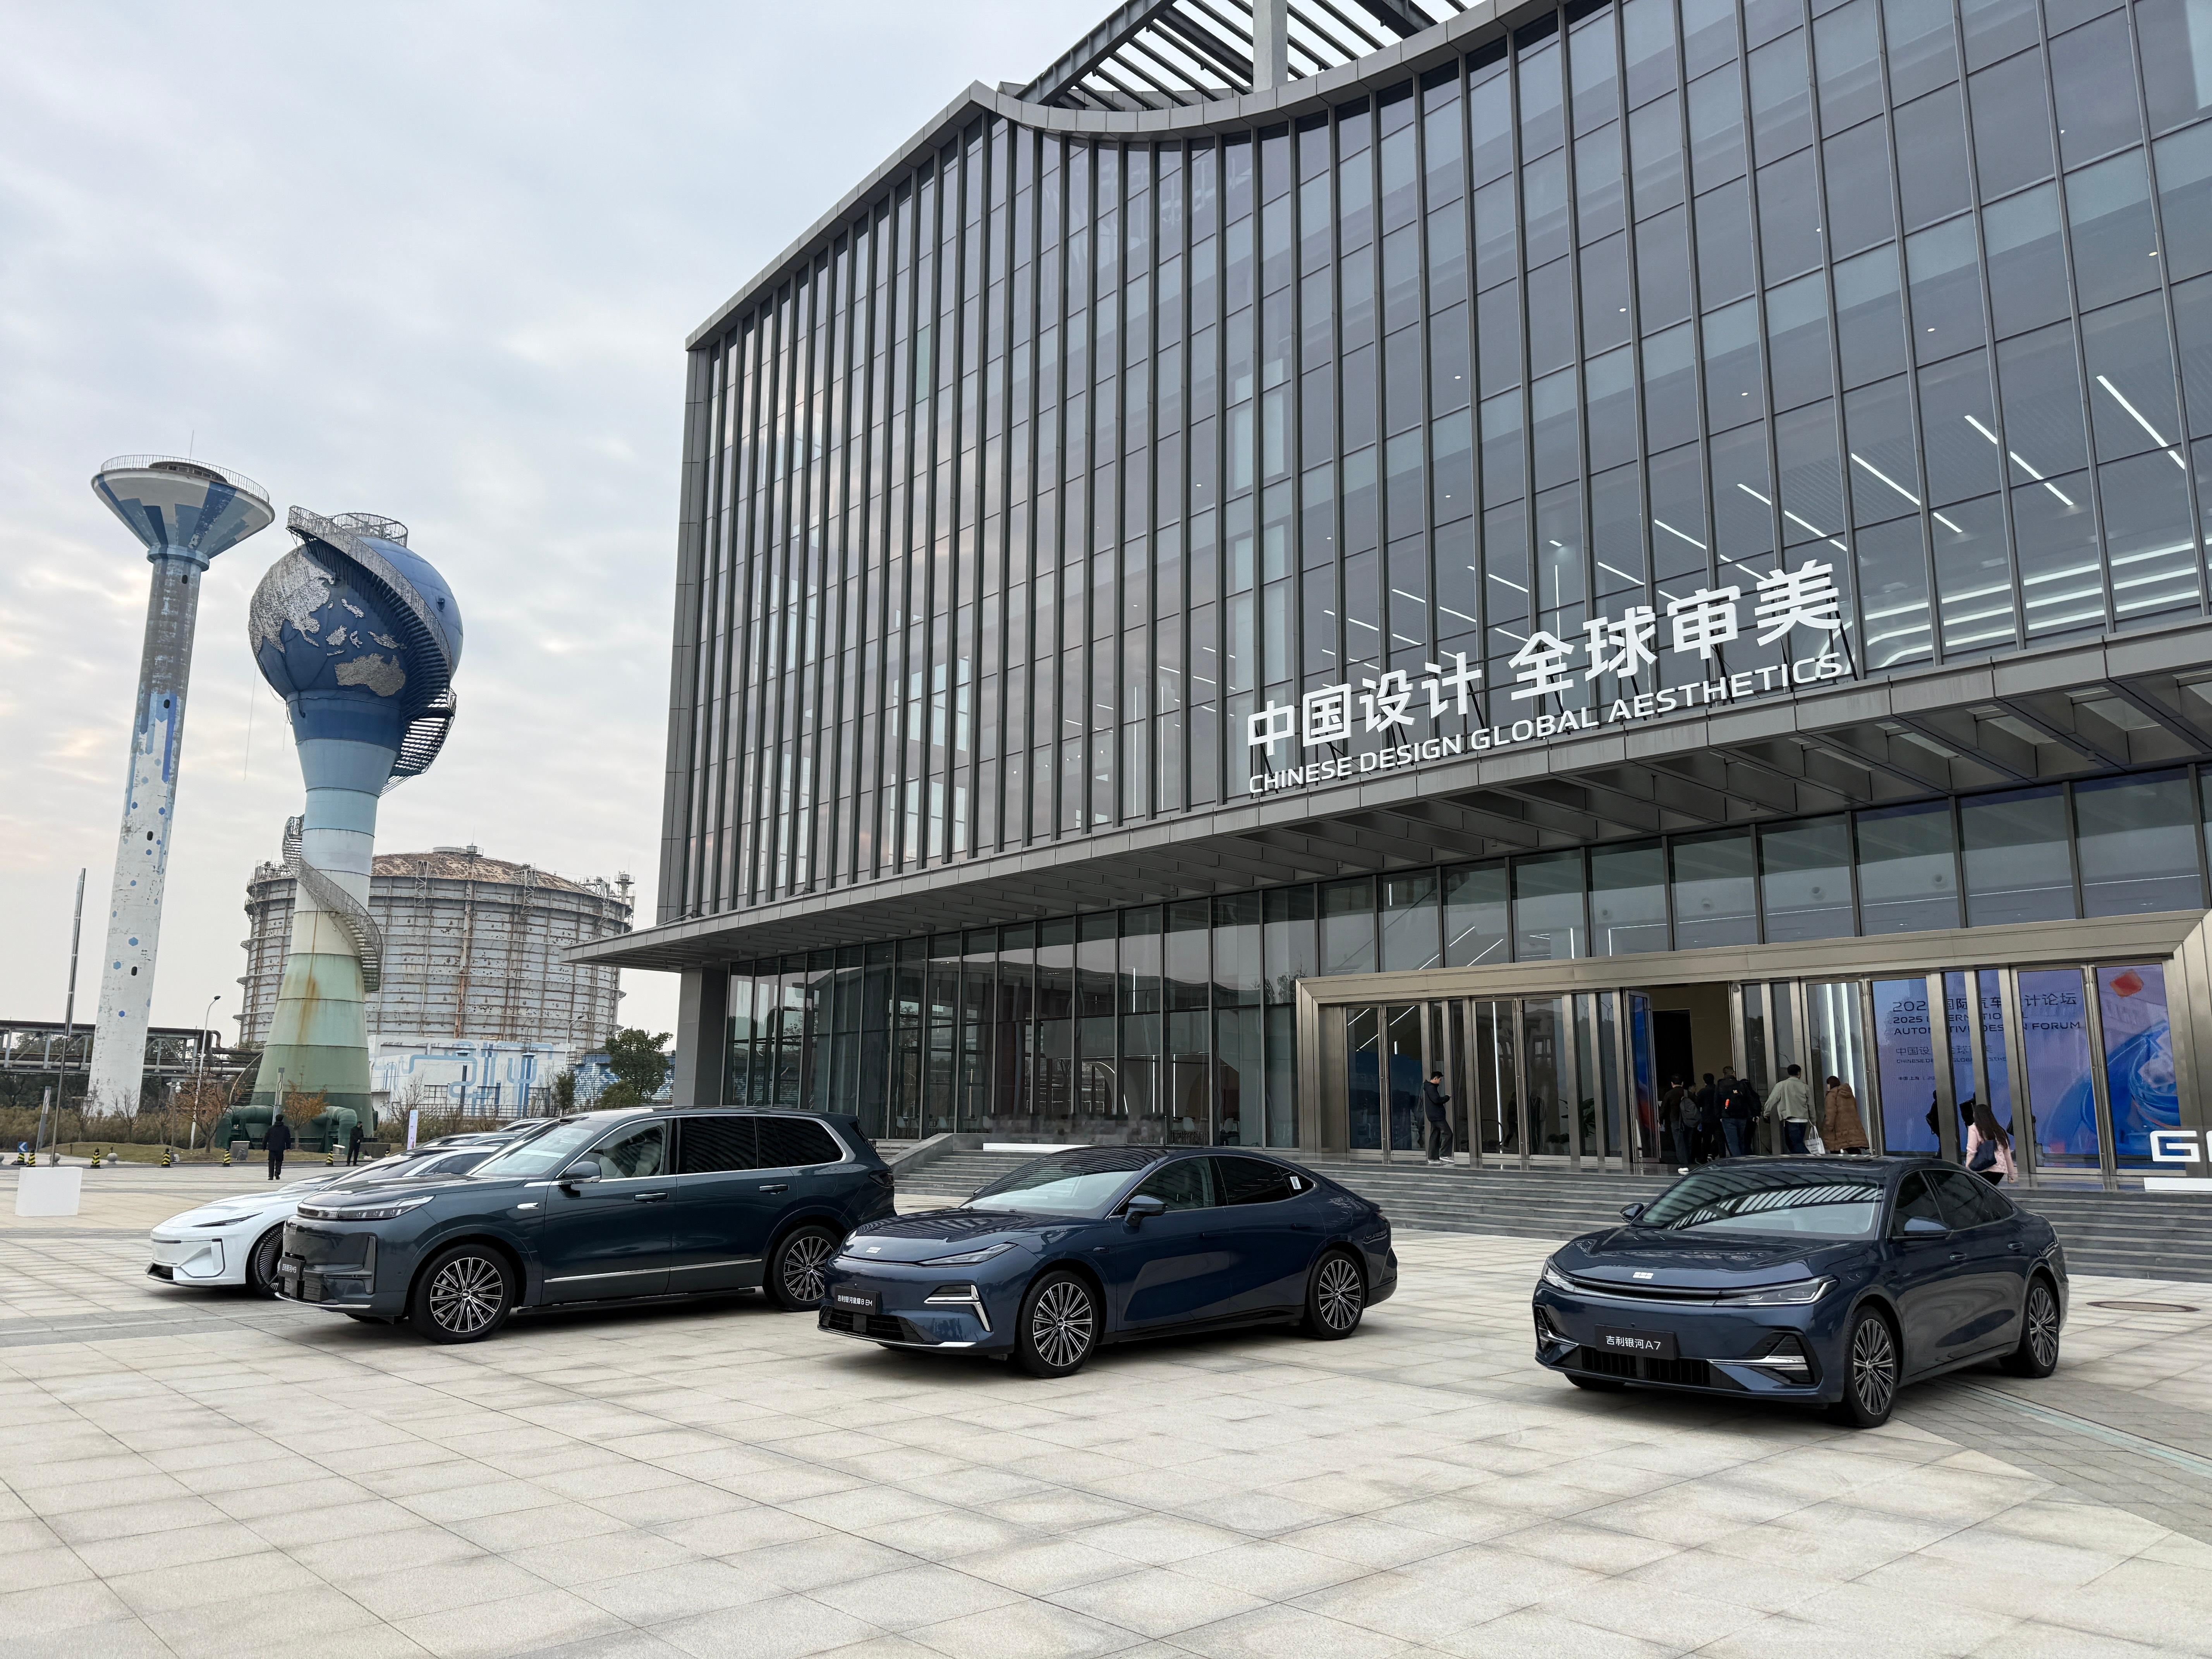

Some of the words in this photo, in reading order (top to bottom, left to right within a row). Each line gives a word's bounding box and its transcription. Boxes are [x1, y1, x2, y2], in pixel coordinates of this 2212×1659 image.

[1248, 652, 1482, 756] 中国设计
[1508, 559, 1841, 701] 全球审美
[1249, 756, 1352, 793] CHINESE
[1360, 734, 1462, 772] DESIGN
[1471, 707, 1599, 750] GLOBAL
[1608, 652, 1842, 723] AESTHETICS
[1927, 1012, 2028, 1022] IERNTIOL
[2032, 1022, 2080, 1030] FORUM
[2150, 1130, 2212, 1162] G
